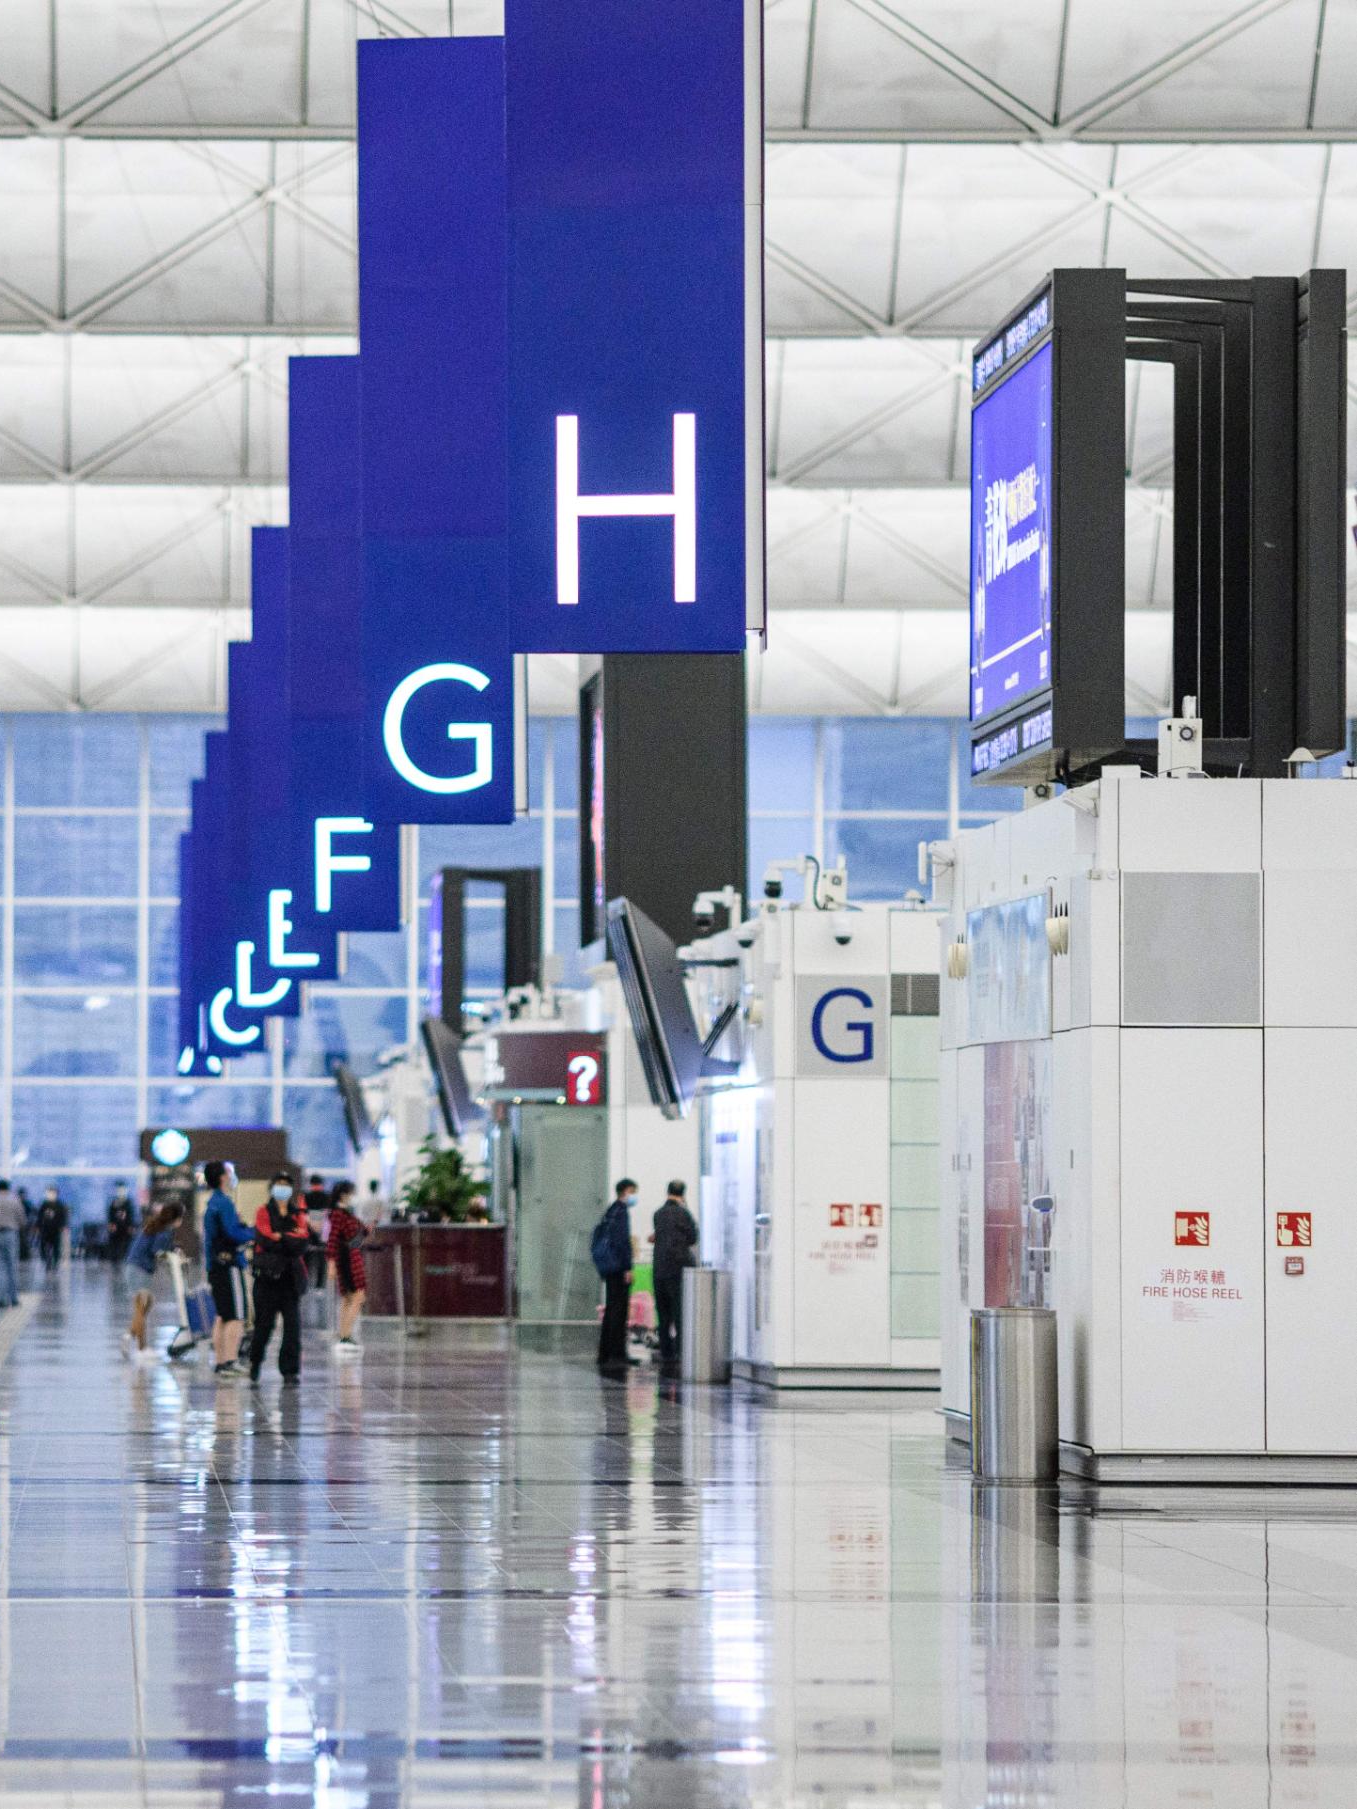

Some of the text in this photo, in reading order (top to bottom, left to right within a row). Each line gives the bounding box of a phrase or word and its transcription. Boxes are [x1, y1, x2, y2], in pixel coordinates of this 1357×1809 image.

[556, 413, 696, 604] H
[383, 662, 493, 794] G
[315, 817, 373, 912] F
[269, 889, 320, 966] E
[811, 987, 874, 1063] G
[1142, 1286, 1243, 1300] FIRE HOSE REEL
